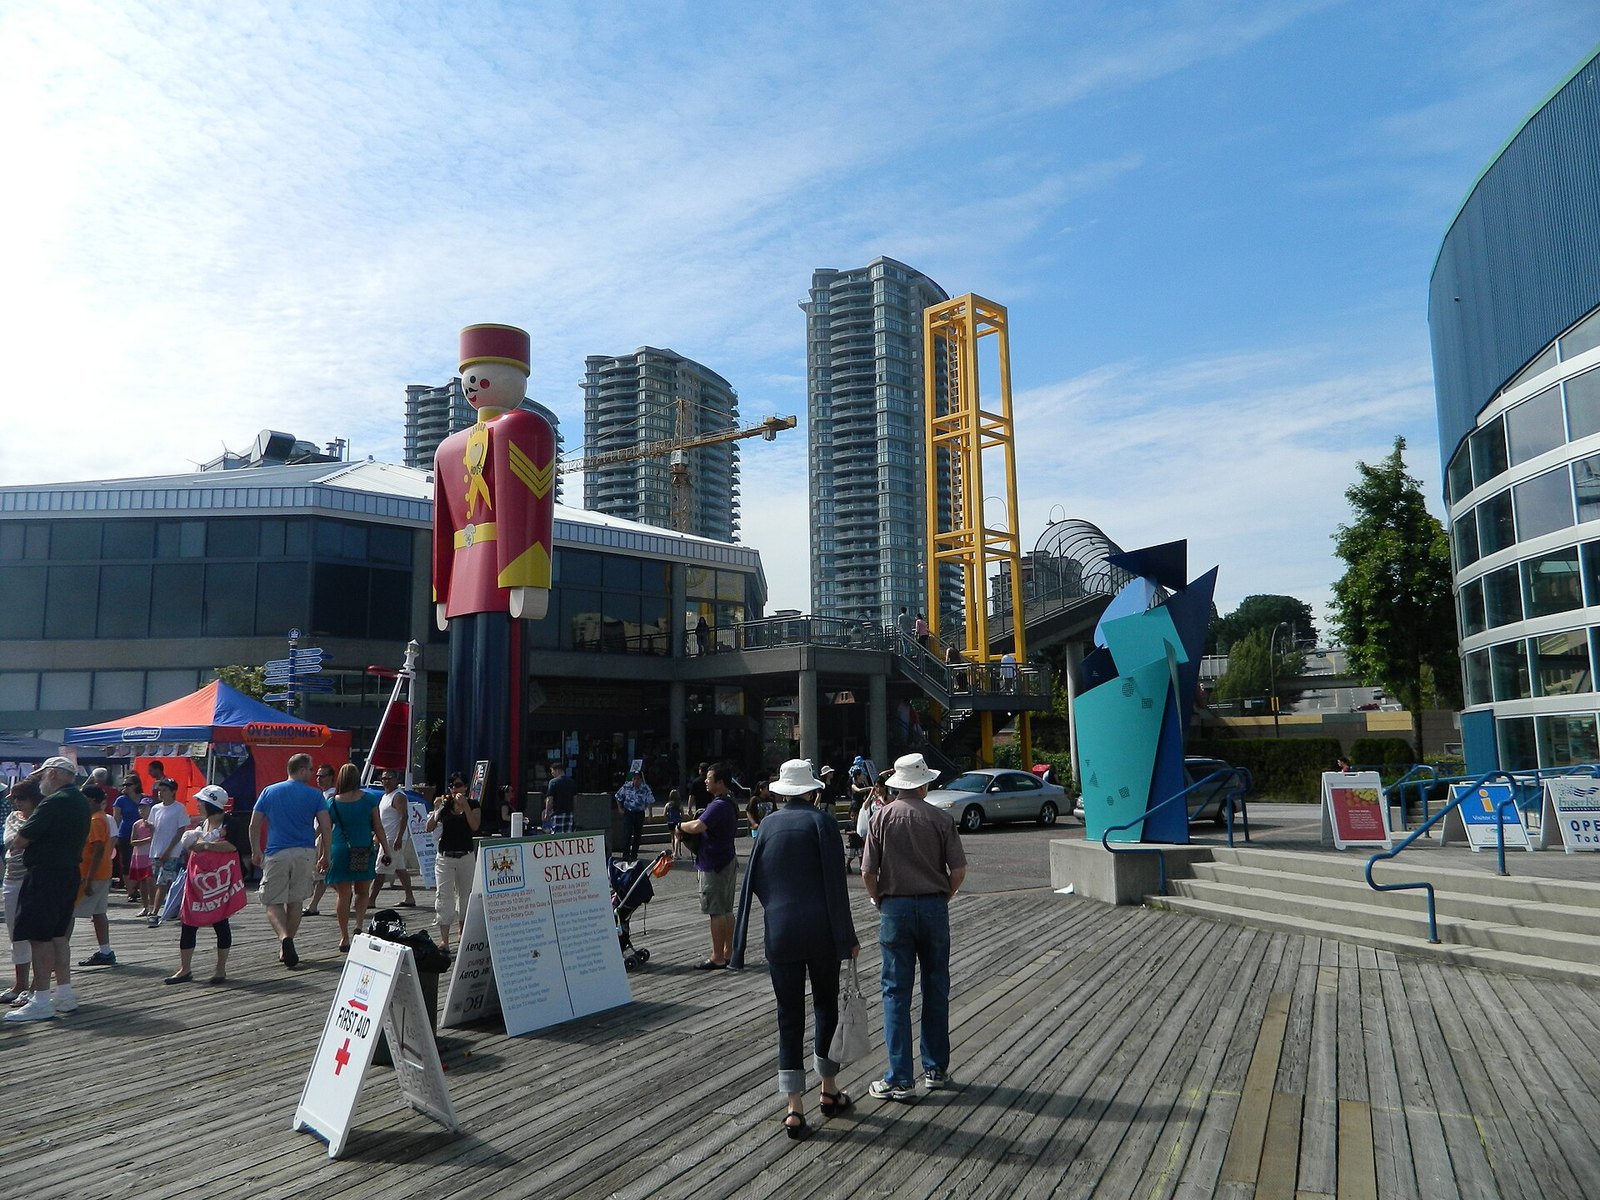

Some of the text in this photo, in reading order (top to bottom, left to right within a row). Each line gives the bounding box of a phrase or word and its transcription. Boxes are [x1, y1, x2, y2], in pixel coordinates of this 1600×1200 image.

[247, 724, 324, 737] OVENMONKEY
[532, 838, 596, 859] CENTRE
[544, 861, 591, 883] STAGE
[335, 1006, 371, 1039] FIRST AID
